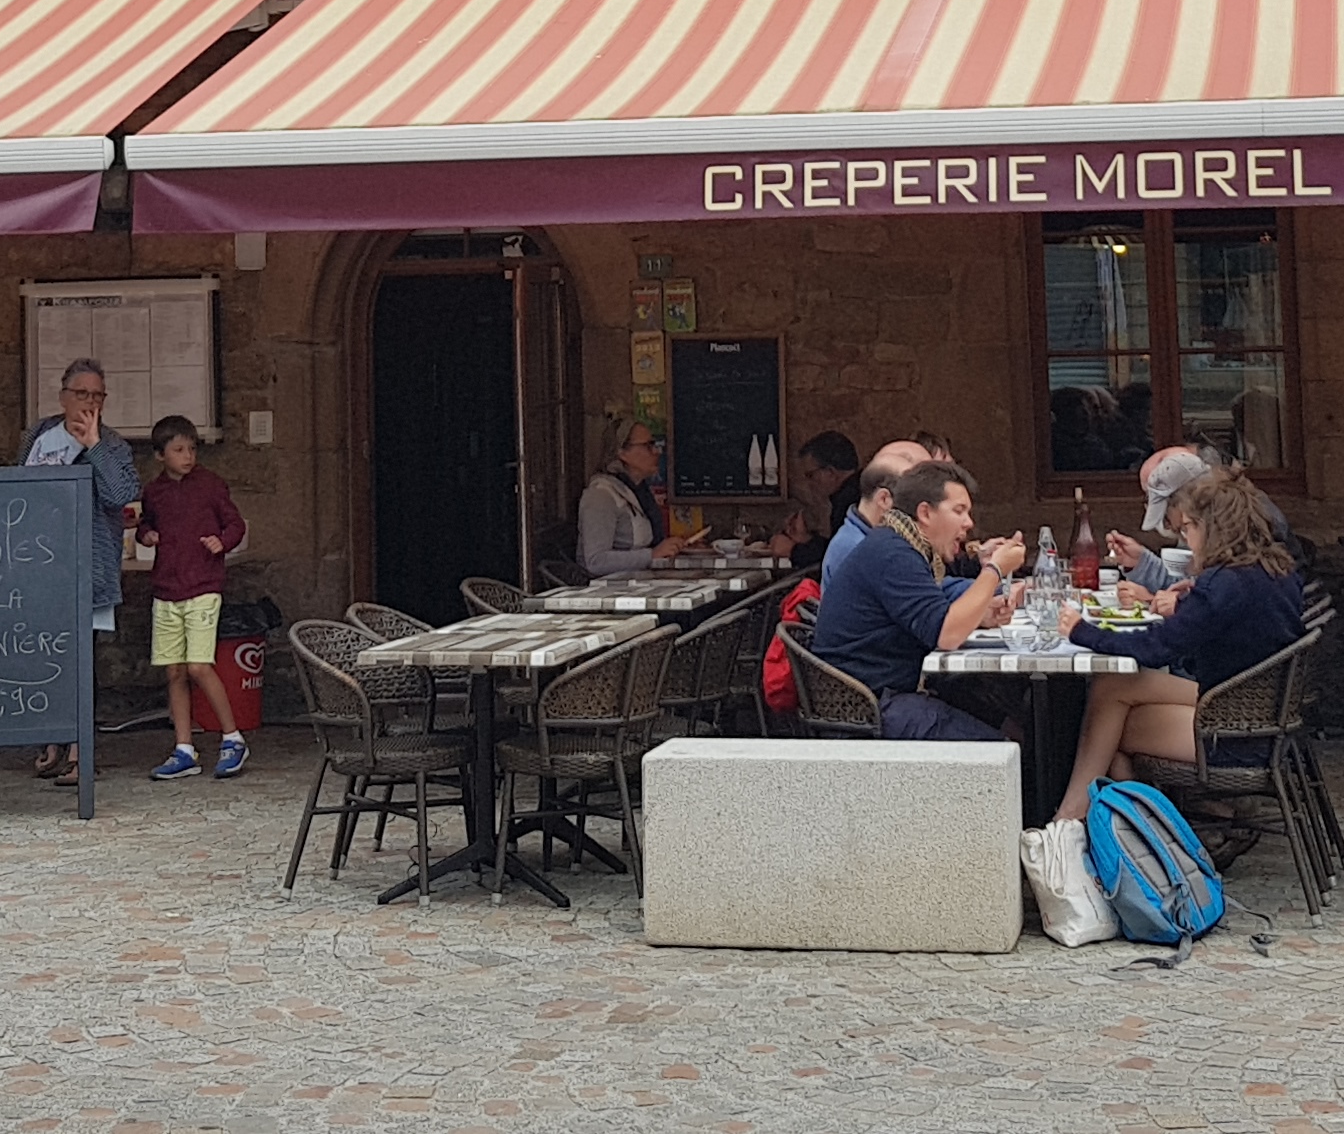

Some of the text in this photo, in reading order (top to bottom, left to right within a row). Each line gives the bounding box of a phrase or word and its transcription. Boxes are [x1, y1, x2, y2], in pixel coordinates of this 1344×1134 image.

[703, 148, 1333, 212] CREPERIE MOREL
[647, 258, 662, 273] 11
